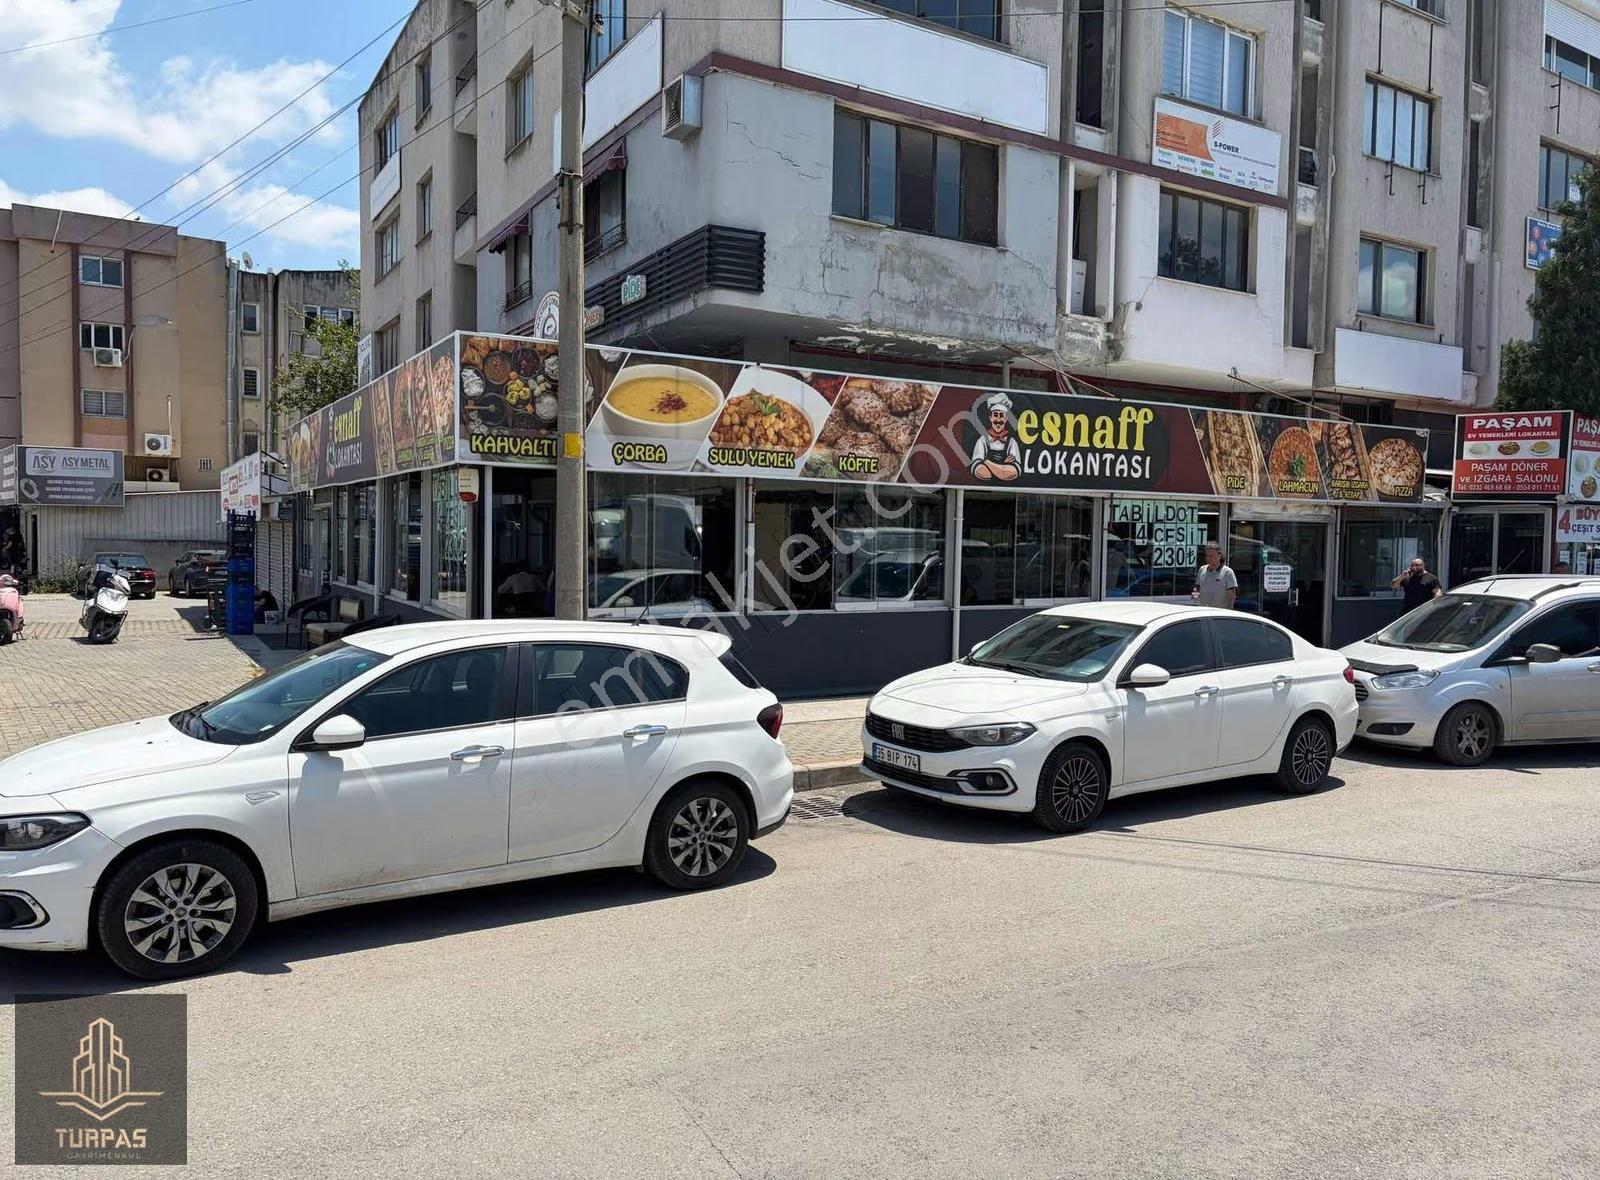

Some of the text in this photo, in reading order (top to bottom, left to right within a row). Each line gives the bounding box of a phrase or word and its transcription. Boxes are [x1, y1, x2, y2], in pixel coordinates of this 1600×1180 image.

[1214, 140, 1240, 153] S-POWER
[334, 396, 363, 444] esnaff
[1017, 405, 1154, 450] esnaff
[1472, 415, 1553, 431] PAŞAM
[470, 434, 557, 458] KAHVALTI
[612, 442, 667, 464] ÇORBA
[33, 455, 57, 469] ASY
[708, 447, 796, 468] SULU YEMEK
[837, 454, 878, 473] KÖFTE
[1023, 449, 1151, 479] LOKANTASI
[1471, 460, 1549, 474] PAŞAM DÖNER
[1278, 480, 1319, 493] LAHMACUN
[1473, 474, 1513, 483] IZGARA
[1515, 473, 1559, 483] SALONU
[1394, 485, 1414, 497] PIZZA
[1559, 509, 1571, 535] 4
[1136, 524, 1147, 544] 4
[903, 754, 917, 768] 174
